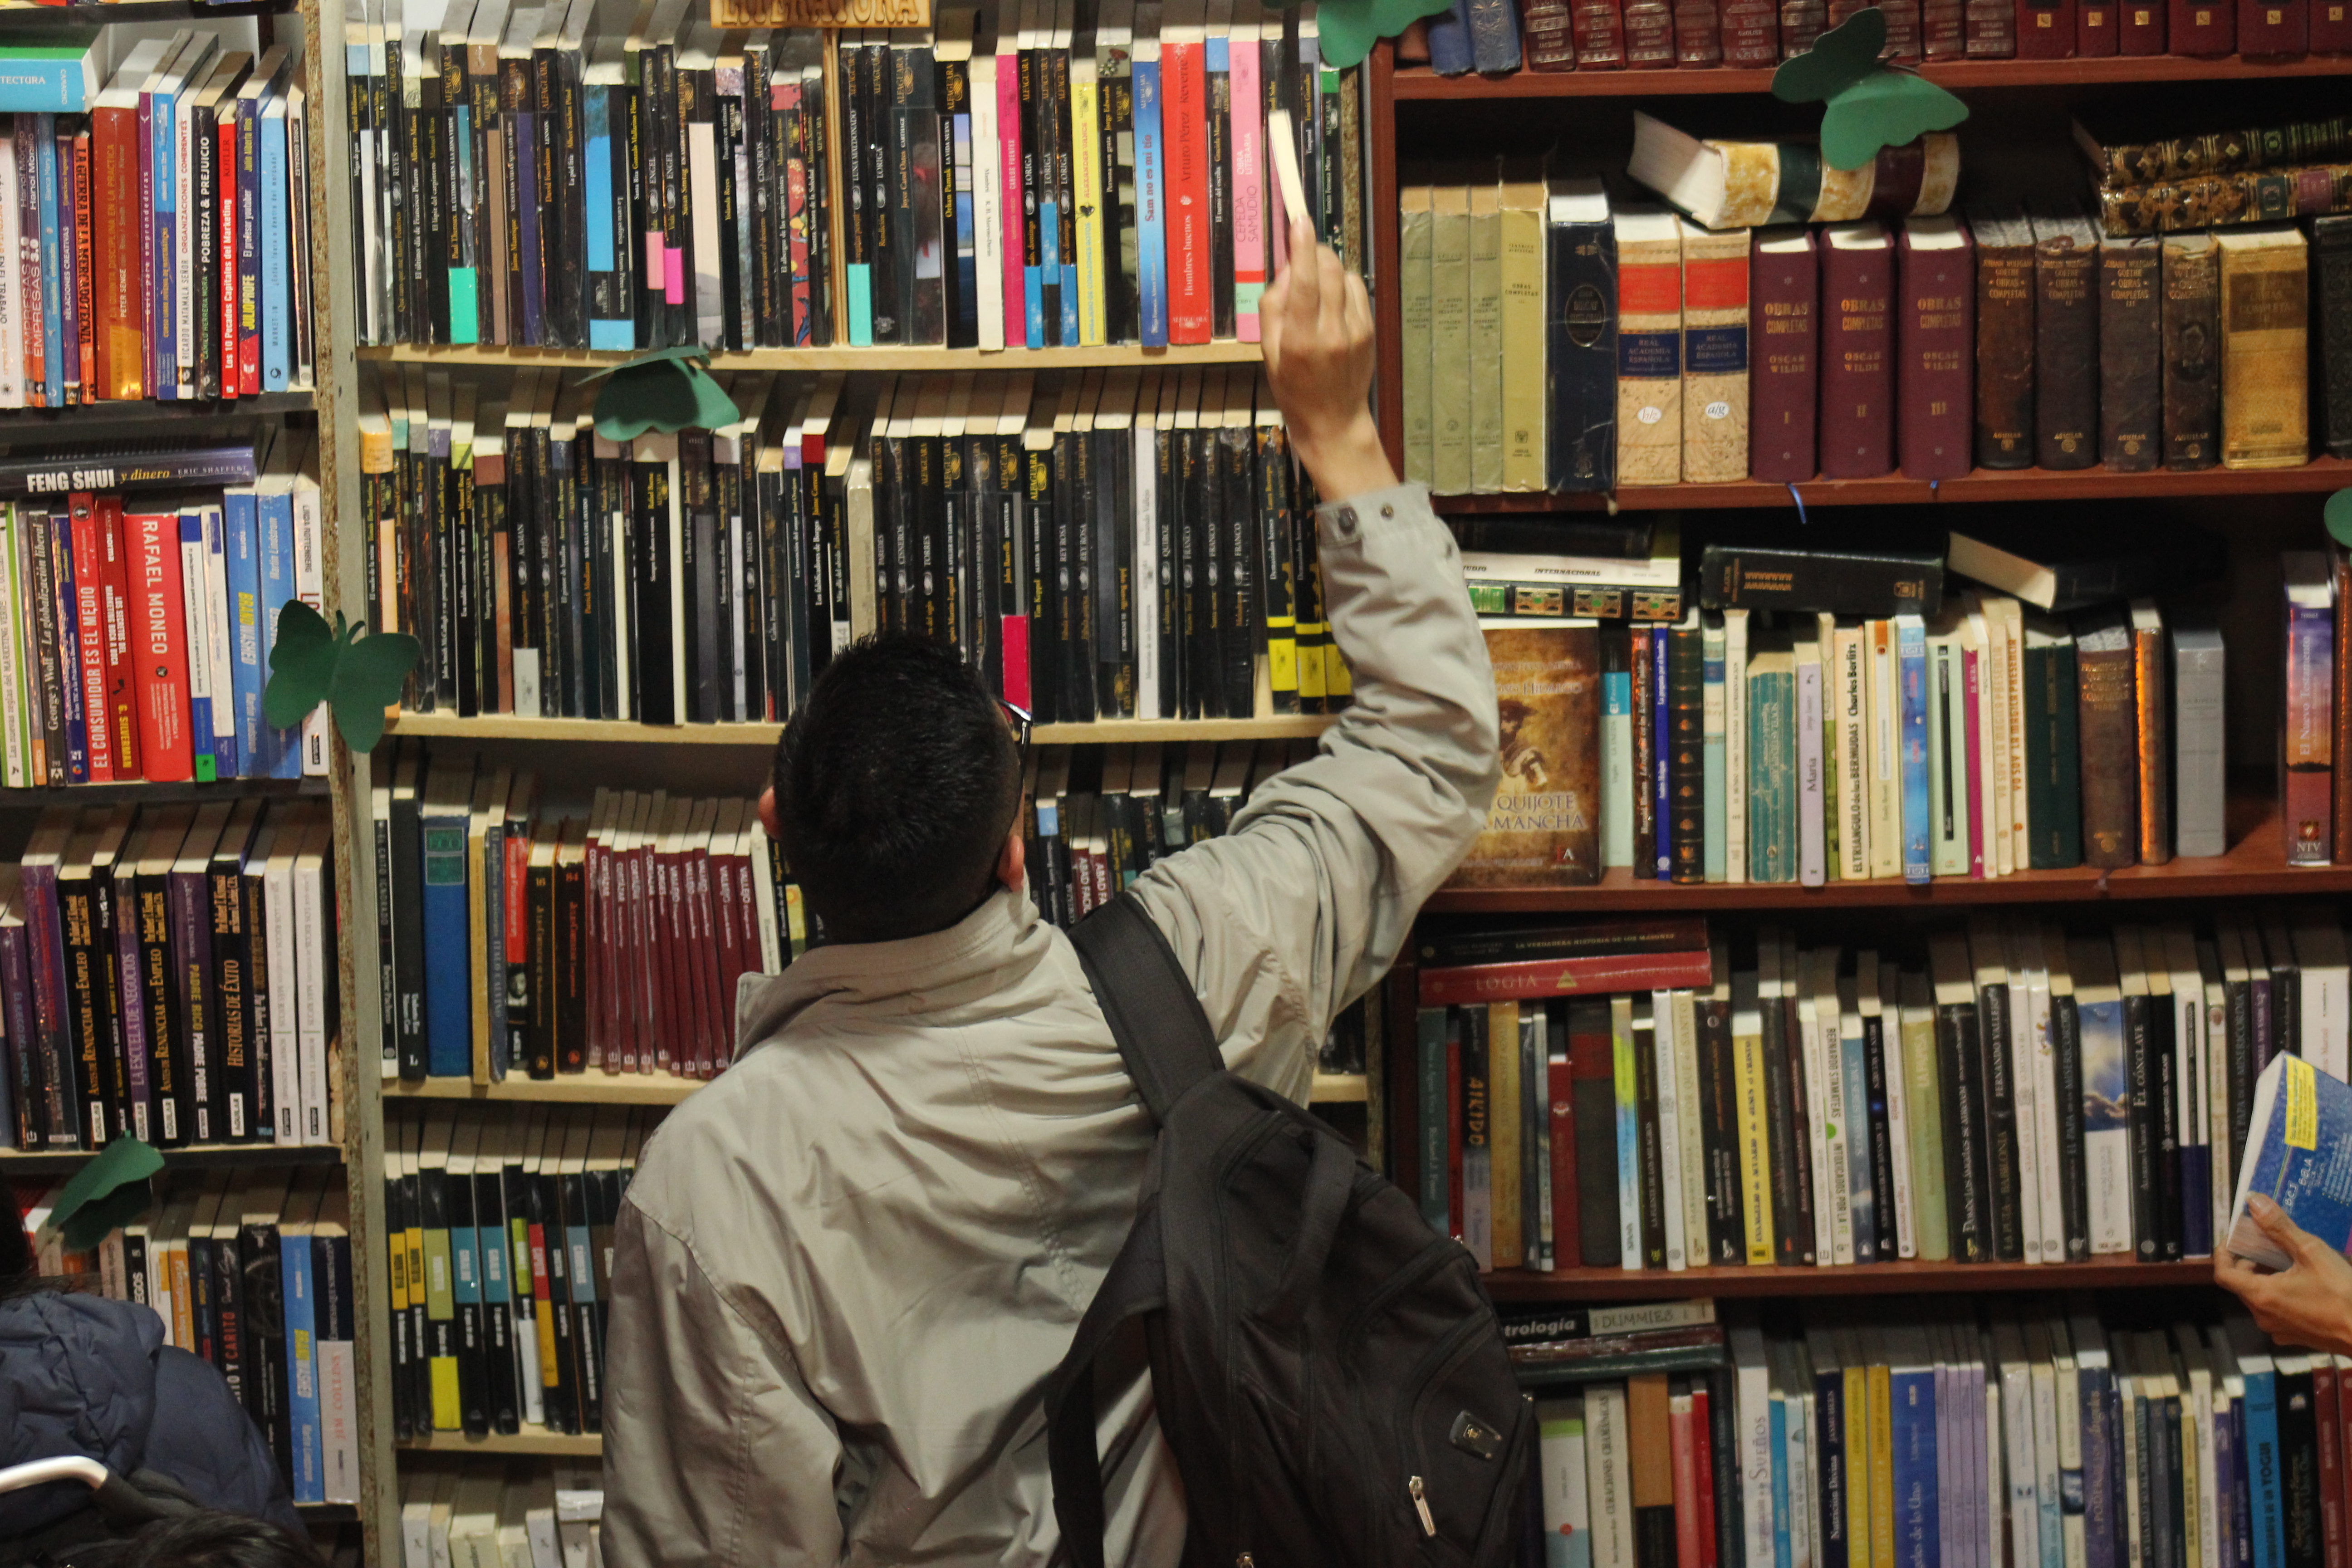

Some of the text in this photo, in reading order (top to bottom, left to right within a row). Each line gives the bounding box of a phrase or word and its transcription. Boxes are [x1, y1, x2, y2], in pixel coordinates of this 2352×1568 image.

[200, 137, 209, 195] PREJUICIO
[1145, 157, 1152, 169] mi
[1146, 172, 1152, 180] es
[76, 164, 87, 210] GUERRA
[1146, 185, 1153, 197] no
[201, 198, 210, 209] &
[1146, 201, 1154, 222] Sam
[1235, 185, 1257, 243] CEPEDA SAMUDIO
[223, 199, 232, 243] Marketing
[201, 212, 210, 263] POBREZA
[223, 246, 231, 259] del
[1183, 215, 1193, 296] Hombres buenos
[224, 261, 233, 300] Capitales
[1996, 278, 2019, 287] OBRAS
[2056, 279, 2078, 288] OBRAS
[2118, 279, 2141, 288] OBRAS
[29, 239, 43, 357] EMPRESAS 3.0
[78, 249, 90, 344] MERCADOTECNIA
[1989, 289, 2027, 299] COMPLETAS
[2048, 290, 2086, 299] COMPLETAS
[2111, 289, 2149, 299] COMPLETAS
[1764, 302, 1809, 316] OBRAS
[1841, 299, 1886, 312] OBRAS
[1917, 298, 1961, 310] OBRAS
[225, 303, 233, 338] Pecados
[1766, 319, 1807, 333] COMPLETAS
[1842, 317, 1883, 331] COMPLETAS
[1920, 314, 1960, 329] COMPLETAS
[225, 340, 233, 351] 10
[1769, 355, 1805, 363] OSCAR
[1844, 352, 1880, 361] OSCAR
[1923, 352, 1959, 360] OSCAR
[1771, 364, 1805, 373] WILDE
[1844, 363, 1879, 372] WILDE
[1923, 362, 1958, 370] WILDE
[27, 469, 170, 493] FENG SHUI y dinero
[1029, 452, 1038, 500] ALFAGUARA
[106, 533, 114, 562] norma
[896, 525, 905, 564] CISNEROS
[1534, 568, 1601, 577] INTERNACIONAL
[142, 520, 168, 654] RAFAEL MONEO
[84, 630, 98, 645] EL
[85, 651, 100, 665] ES
[1523, 683, 1582, 694] HIDALGO
[1847, 680, 1857, 716] Charles
[87, 669, 106, 750] CONSUMIDOR
[2300, 703, 2310, 739] Nuevo
[93, 753, 107, 768] EL
[1497, 794, 1574, 811] QUIJOTE
[1494, 817, 1584, 831] MANCHA
[2297, 843, 2321, 852] NTV
[1079, 857, 1090, 885] ABAD
[1096, 863, 1106, 891] ABAD
[740, 866, 750, 903] VALLEJO
[150, 948, 163, 986] EMPLEO
[122, 954, 138, 1005] NEGOCIOS
[220, 960, 244, 1067] HISTORIAS DE ÉXITO
[189, 964, 207, 1102] PADRE RICO PADRE POBRE
[128, 1024, 143, 1069] ESCUELA
[1826, 1028, 1841, 1119] BERNARDO STAMATEAS
[2134, 1089, 2147, 1107] EL
